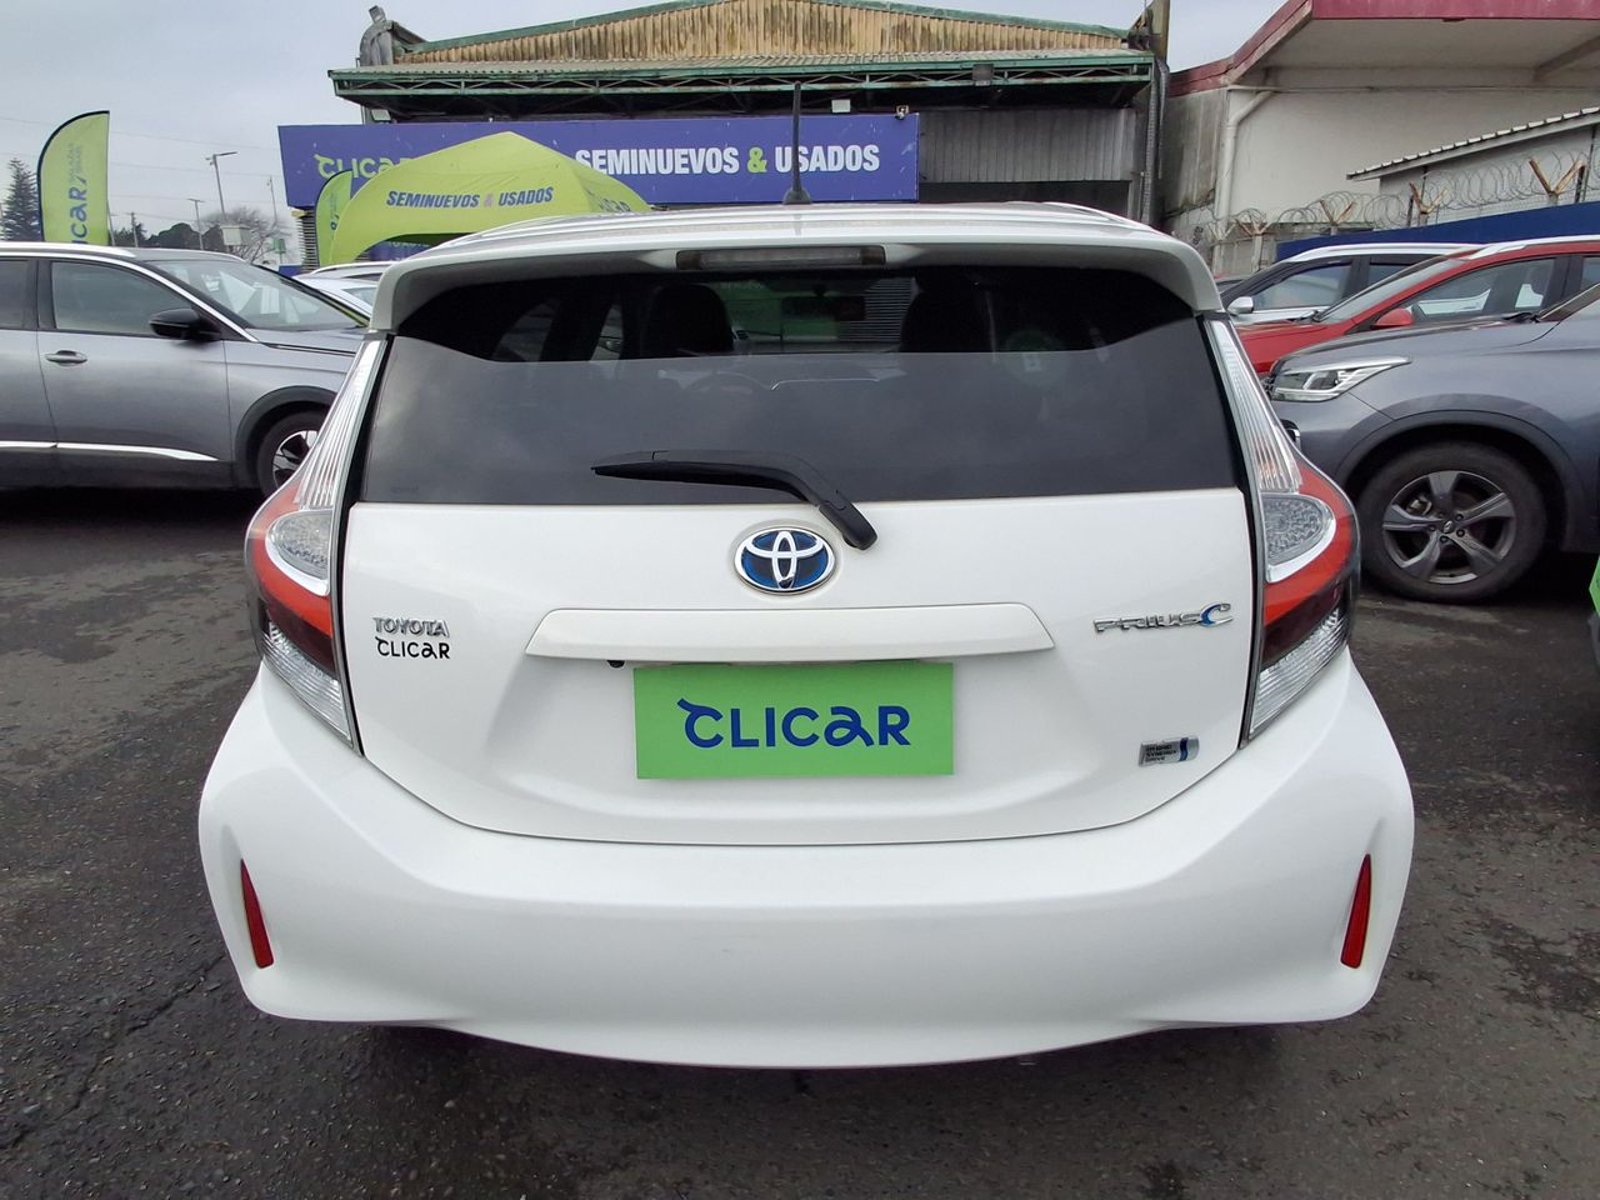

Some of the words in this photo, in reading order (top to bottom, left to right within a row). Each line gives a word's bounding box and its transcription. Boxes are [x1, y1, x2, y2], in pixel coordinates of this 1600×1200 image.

[575, 147, 740, 175] SEMINUEVOS
[747, 146, 767, 174] &
[775, 144, 880, 172] USADOS
[386, 190, 481, 209] SEMINUEVOS
[498, 186, 554, 207] USADOS
[372, 617, 450, 639] TOYOTA
